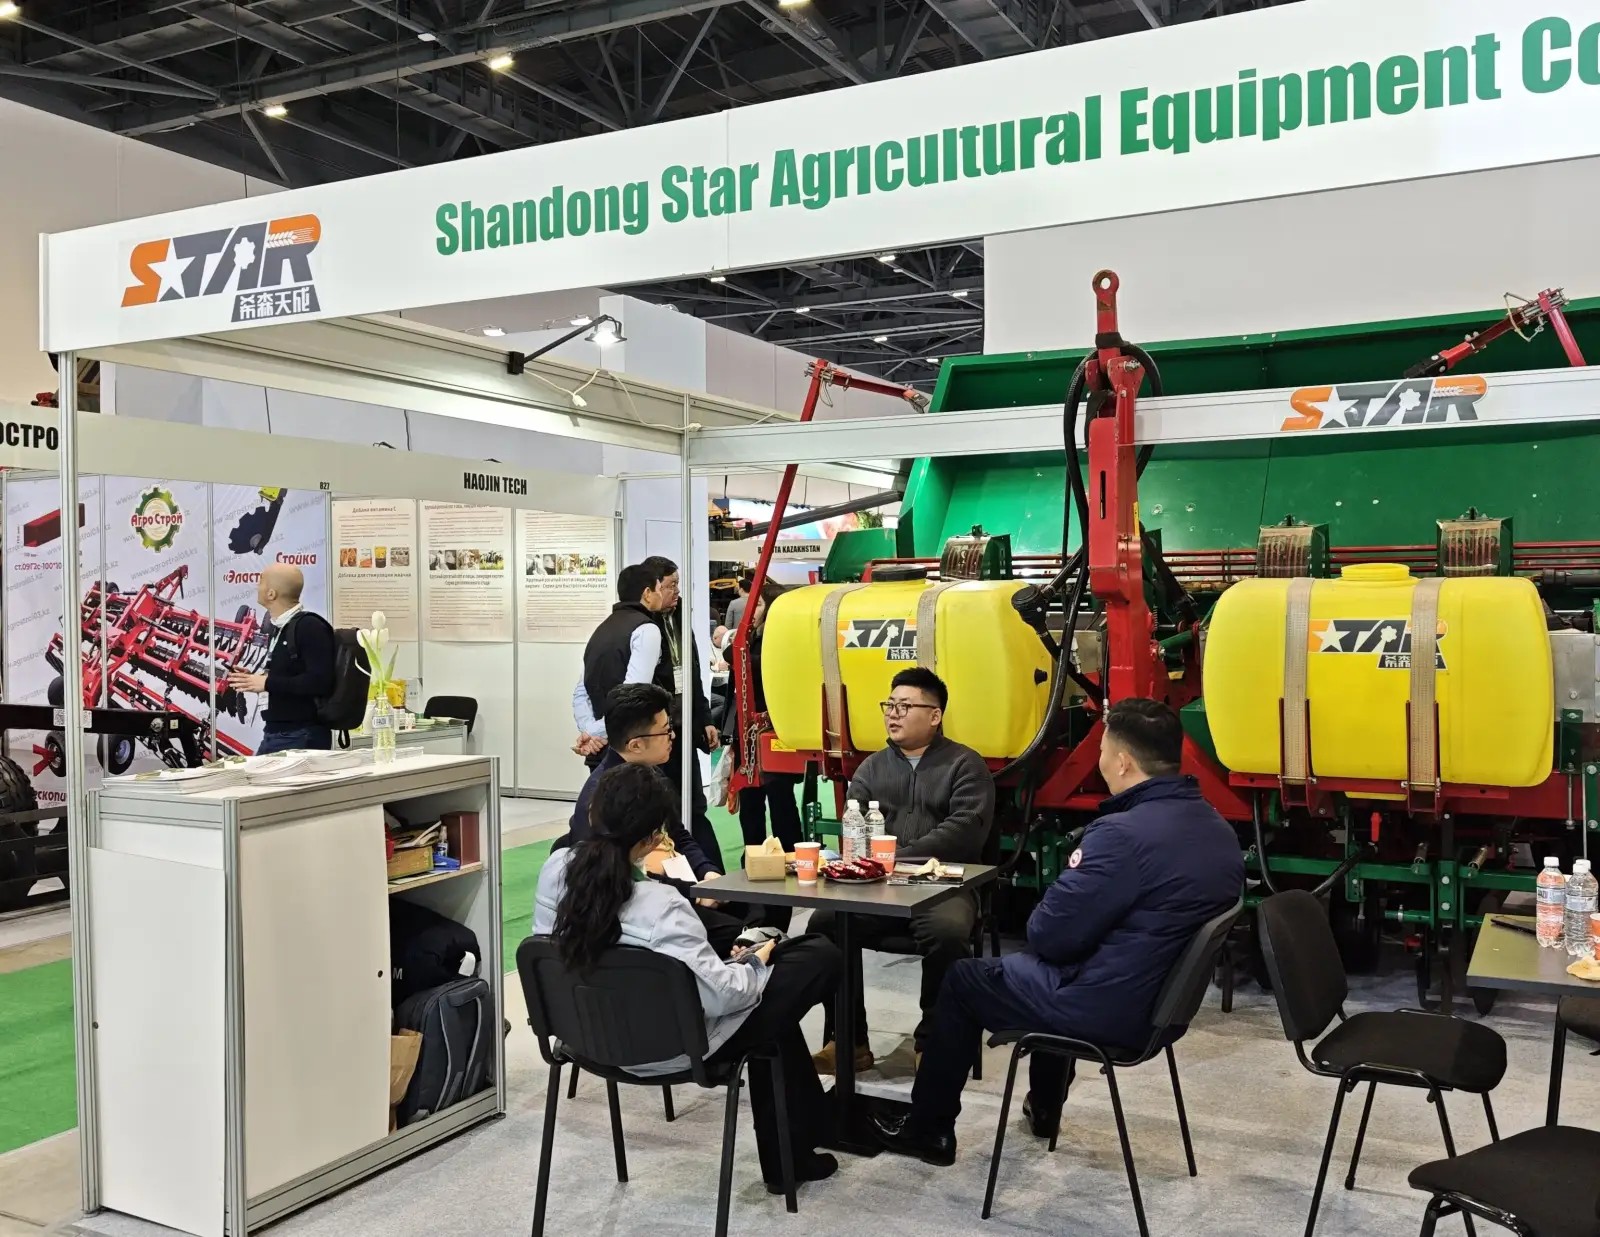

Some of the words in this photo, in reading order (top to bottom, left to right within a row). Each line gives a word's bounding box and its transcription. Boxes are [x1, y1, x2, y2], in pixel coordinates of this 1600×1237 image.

[436, 183, 649, 256] Shandong
[661, 164, 759, 223] Star
[771, 95, 1102, 210] Agricultural
[1121, 34, 1501, 155] Equipment
[121, 213, 321, 308] STAR
[239, 286, 311, 320] 希森天成
[1280, 375, 1488, 432] STAR
[463, 472, 500, 493] HAOJIN
[502, 476, 527, 495] TECH
[276, 552, 317, 565] Стойка
[782, 545, 820, 553] KAZAKHSTAN
[223, 570, 263, 584] «Эласт
